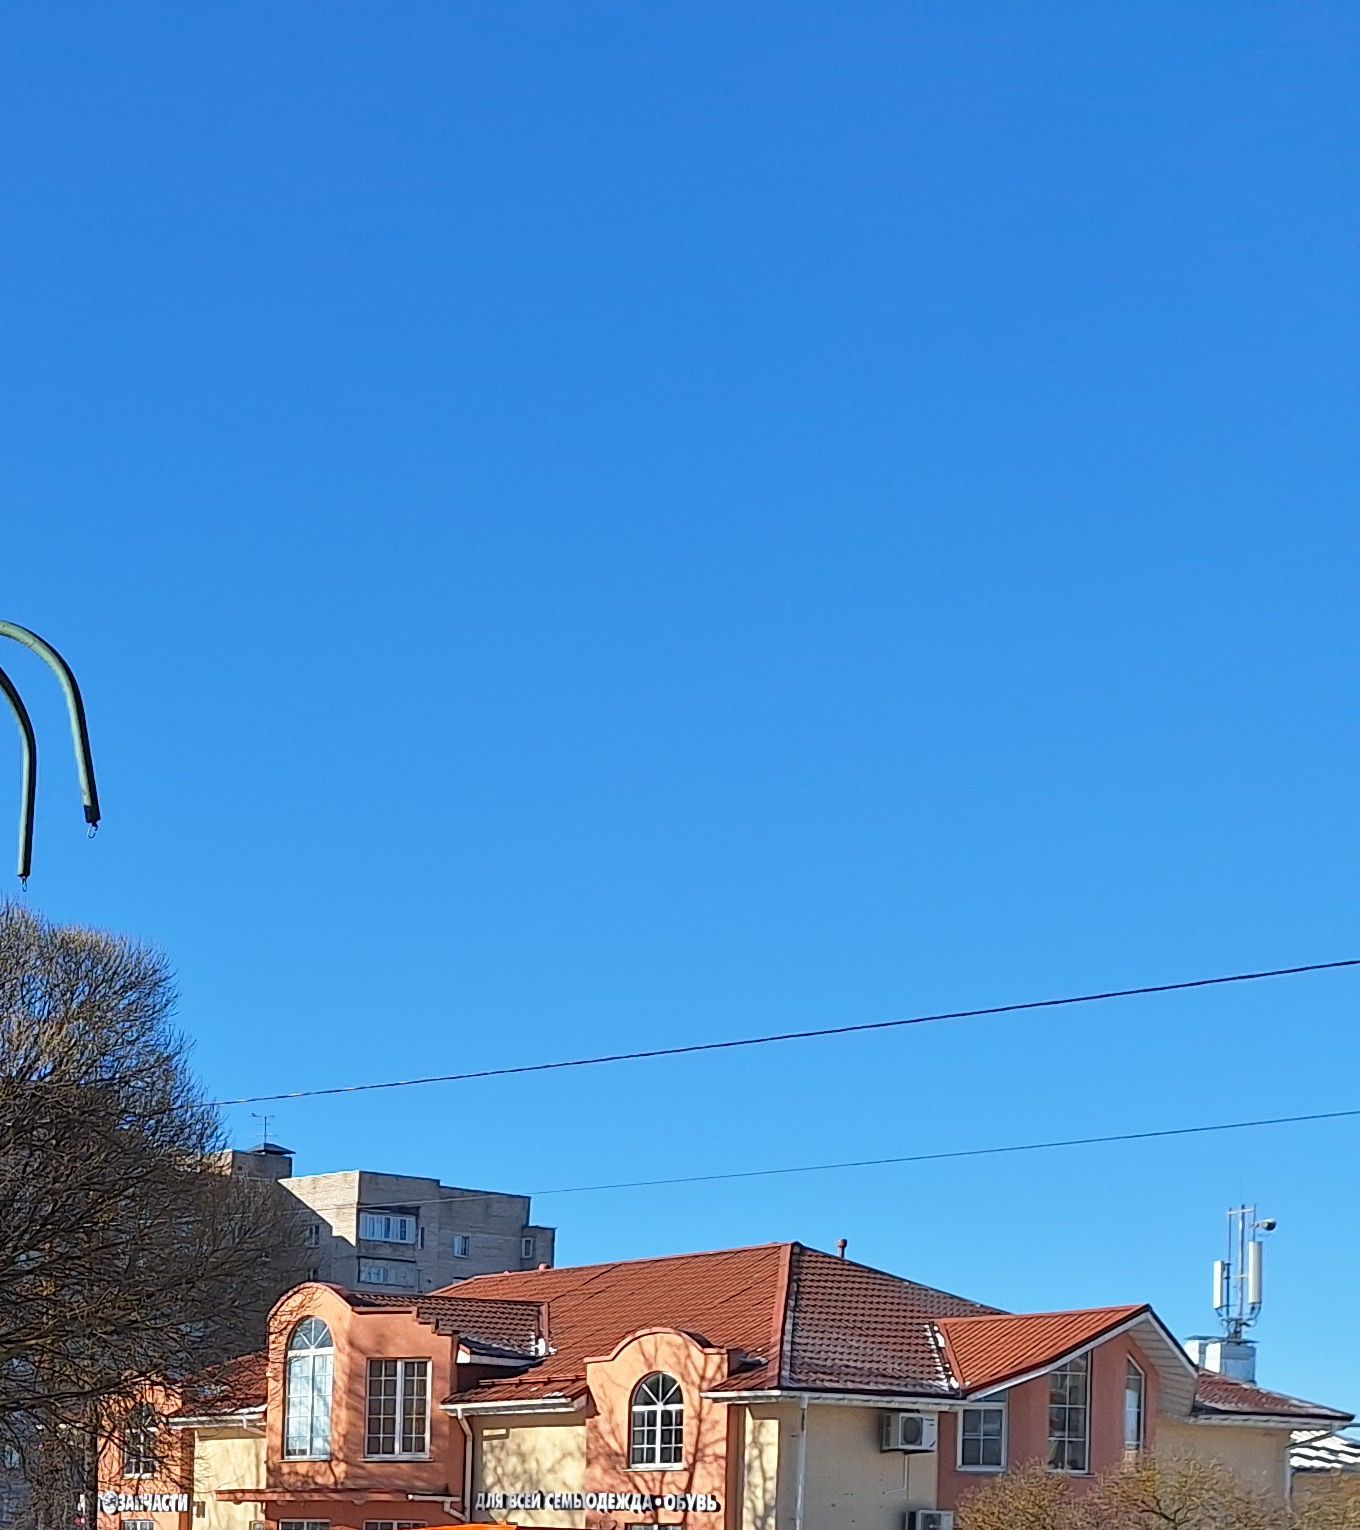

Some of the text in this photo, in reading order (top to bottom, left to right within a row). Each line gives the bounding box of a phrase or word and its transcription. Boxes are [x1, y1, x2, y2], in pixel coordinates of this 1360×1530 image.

[475, 1489, 717, 1512] ДЛЯ ВСЕЙ СЕМЬ ОДЕЖДА ОБУВЬ
